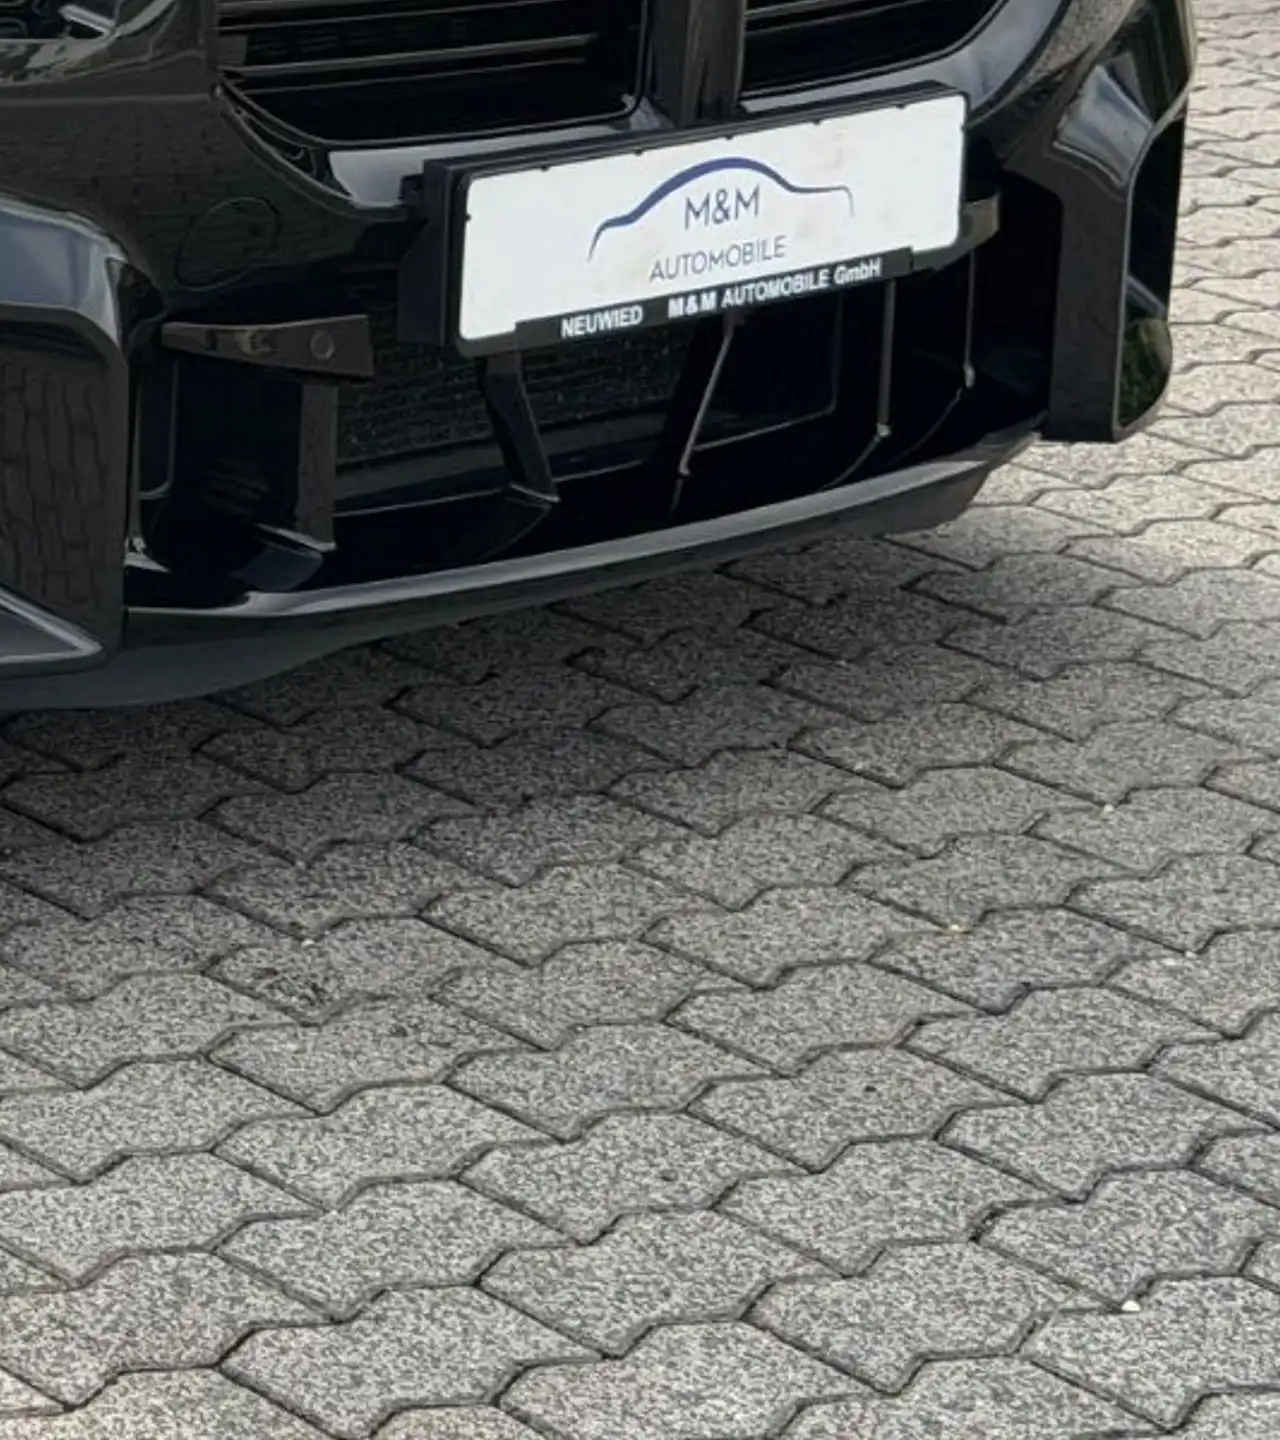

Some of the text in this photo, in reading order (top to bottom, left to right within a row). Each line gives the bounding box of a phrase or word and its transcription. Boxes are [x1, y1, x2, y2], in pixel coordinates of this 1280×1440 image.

[684, 184, 761, 231] M&M
[648, 235, 788, 284] AUTOMOBILE
[560, 256, 883, 339] NEUWIED M&M AUTOMOBILE GmbH
